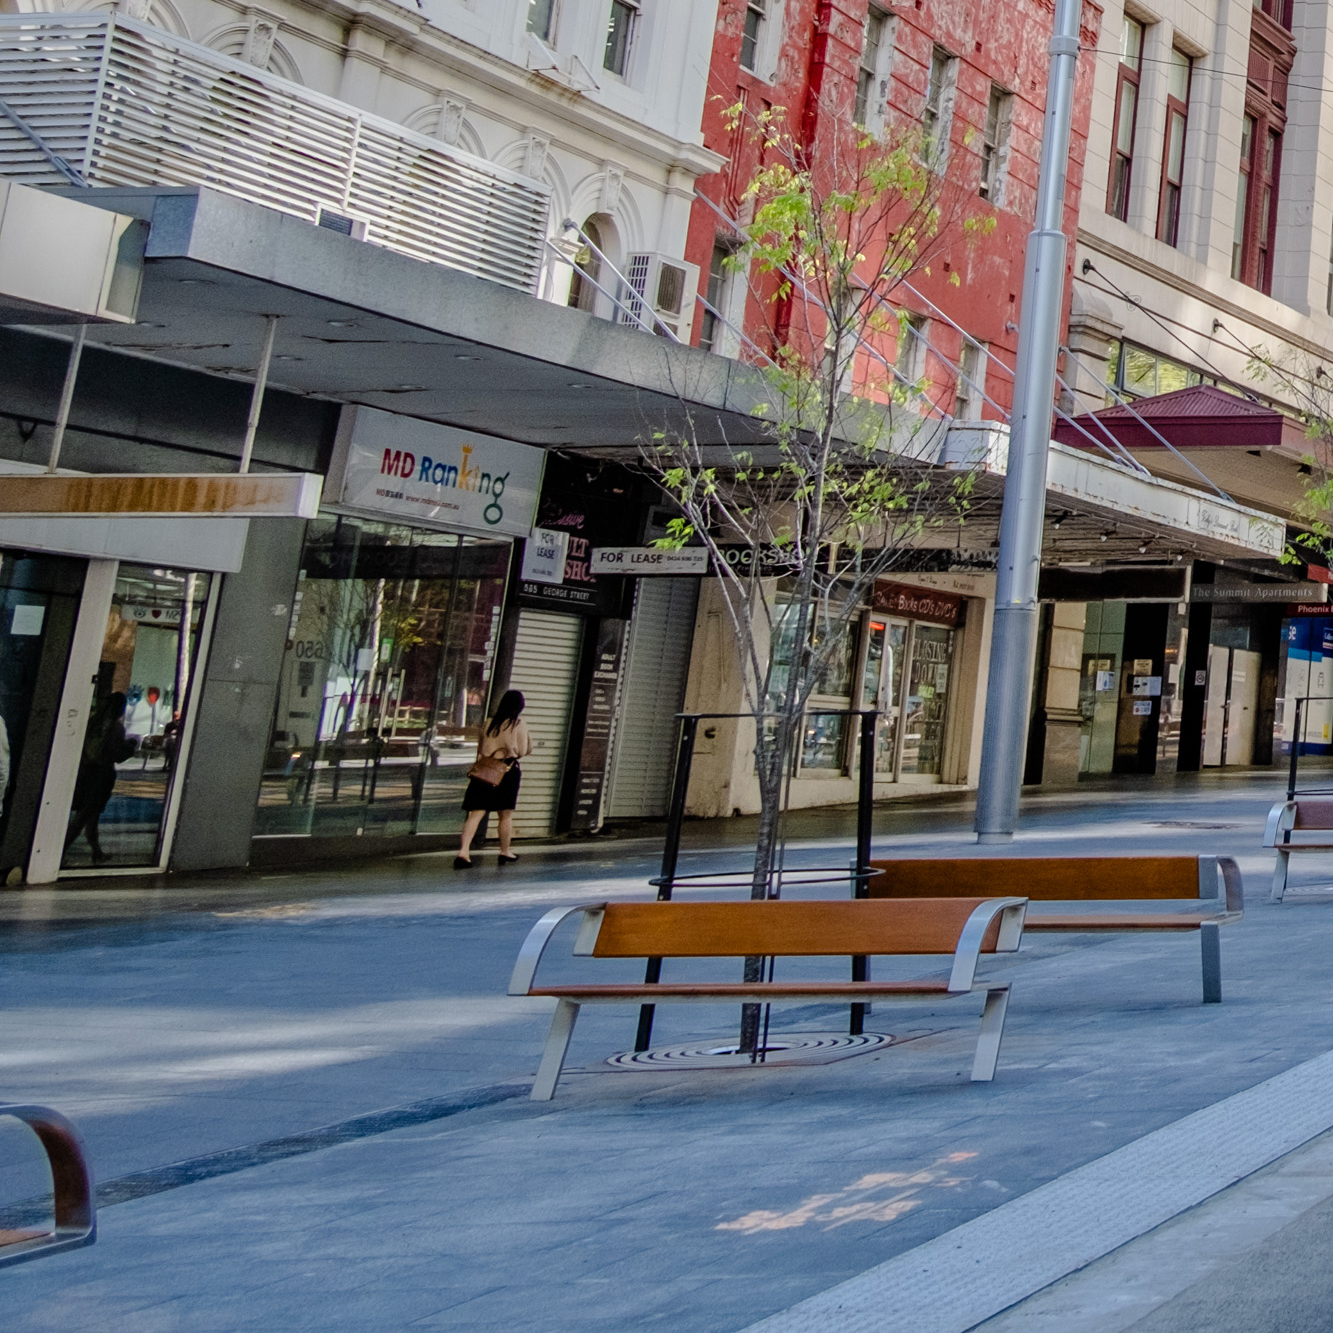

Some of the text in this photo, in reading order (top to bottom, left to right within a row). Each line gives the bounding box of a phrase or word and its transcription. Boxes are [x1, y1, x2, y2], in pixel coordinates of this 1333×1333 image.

[380, 447, 416, 479] MD
[541, 533, 555, 546] FOR
[537, 547, 555, 560] LEASE
[600, 552, 624, 563] FOR
[631, 553, 664, 564] LEASE
[543, 586, 568, 598] GEORGE
[570, 590, 590, 600] STREET
[1193, 586, 1313, 599] The Summit Apartments
[898, 594, 918, 612] Books
[1298, 605, 1330, 614] Phoenix
